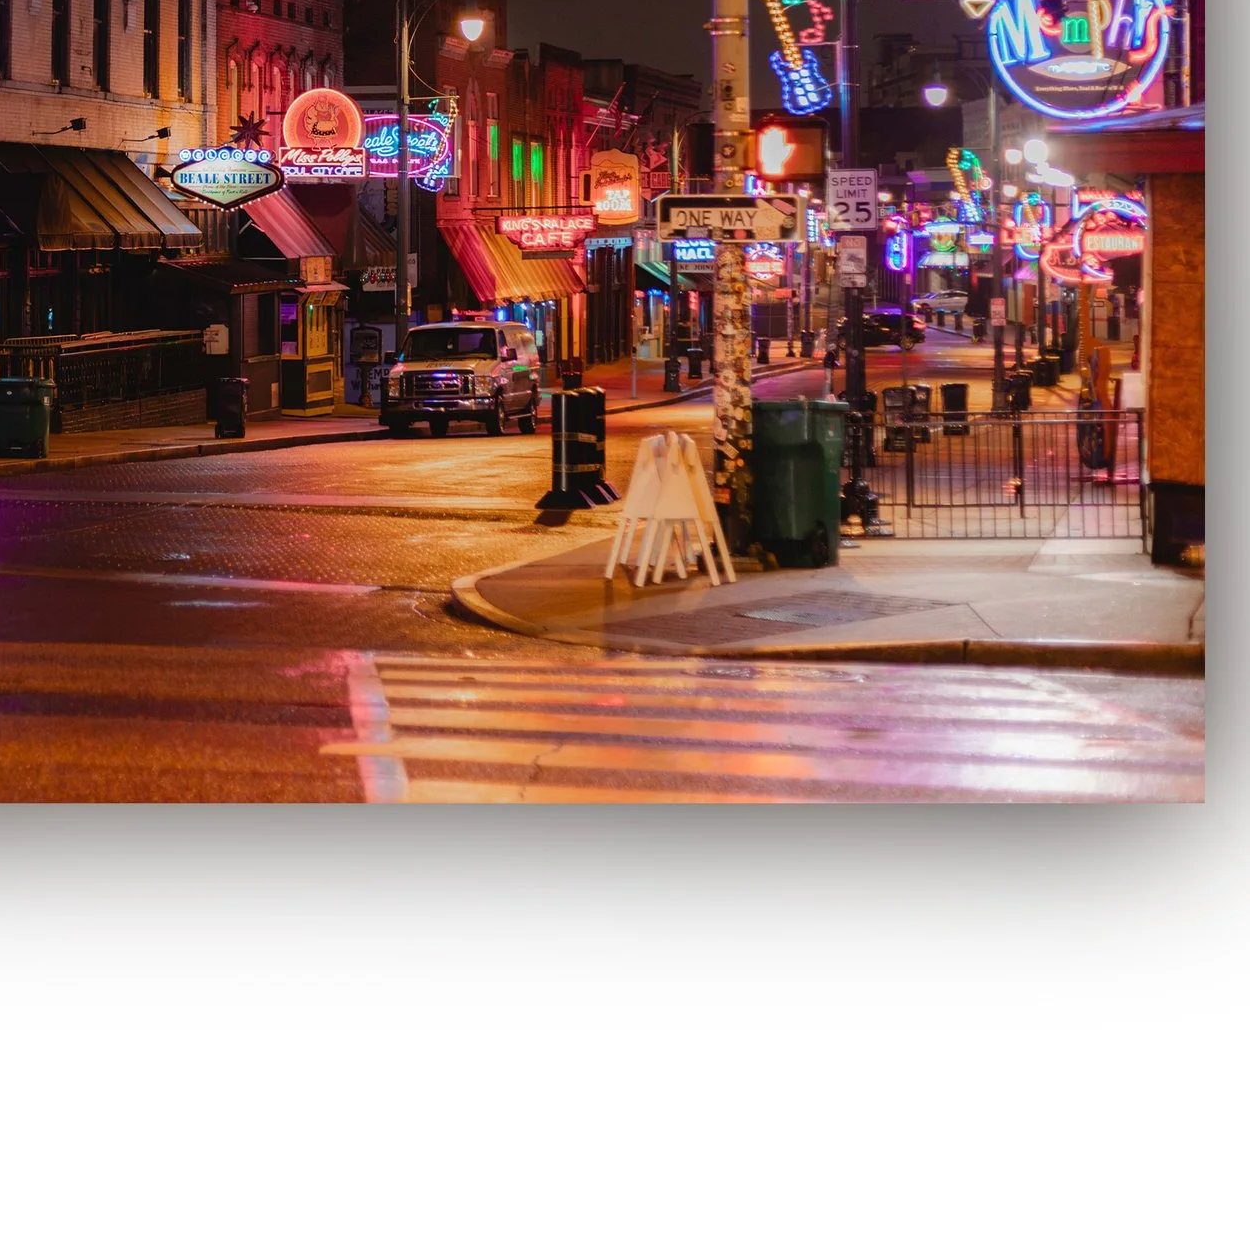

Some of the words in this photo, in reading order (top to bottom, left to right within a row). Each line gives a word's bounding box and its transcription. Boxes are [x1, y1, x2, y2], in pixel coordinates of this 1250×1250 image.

[281, 149, 318, 163] Miss
[281, 166, 311, 176] SOUL
[311, 166, 333, 176] CITY
[180, 173, 220, 184] BEALE
[223, 173, 271, 184] STREET
[831, 176, 873, 187] SPEED
[836, 189, 868, 199] LIMIT
[677, 210, 712, 227] ONE
[720, 210, 758, 227] WAY
[833, 201, 872, 224] 25
[502, 217, 539, 231] KING'S
[539, 217, 594, 230] PALACE
[521, 232, 574, 246] CAFE
[676, 248, 715, 260] HALL
